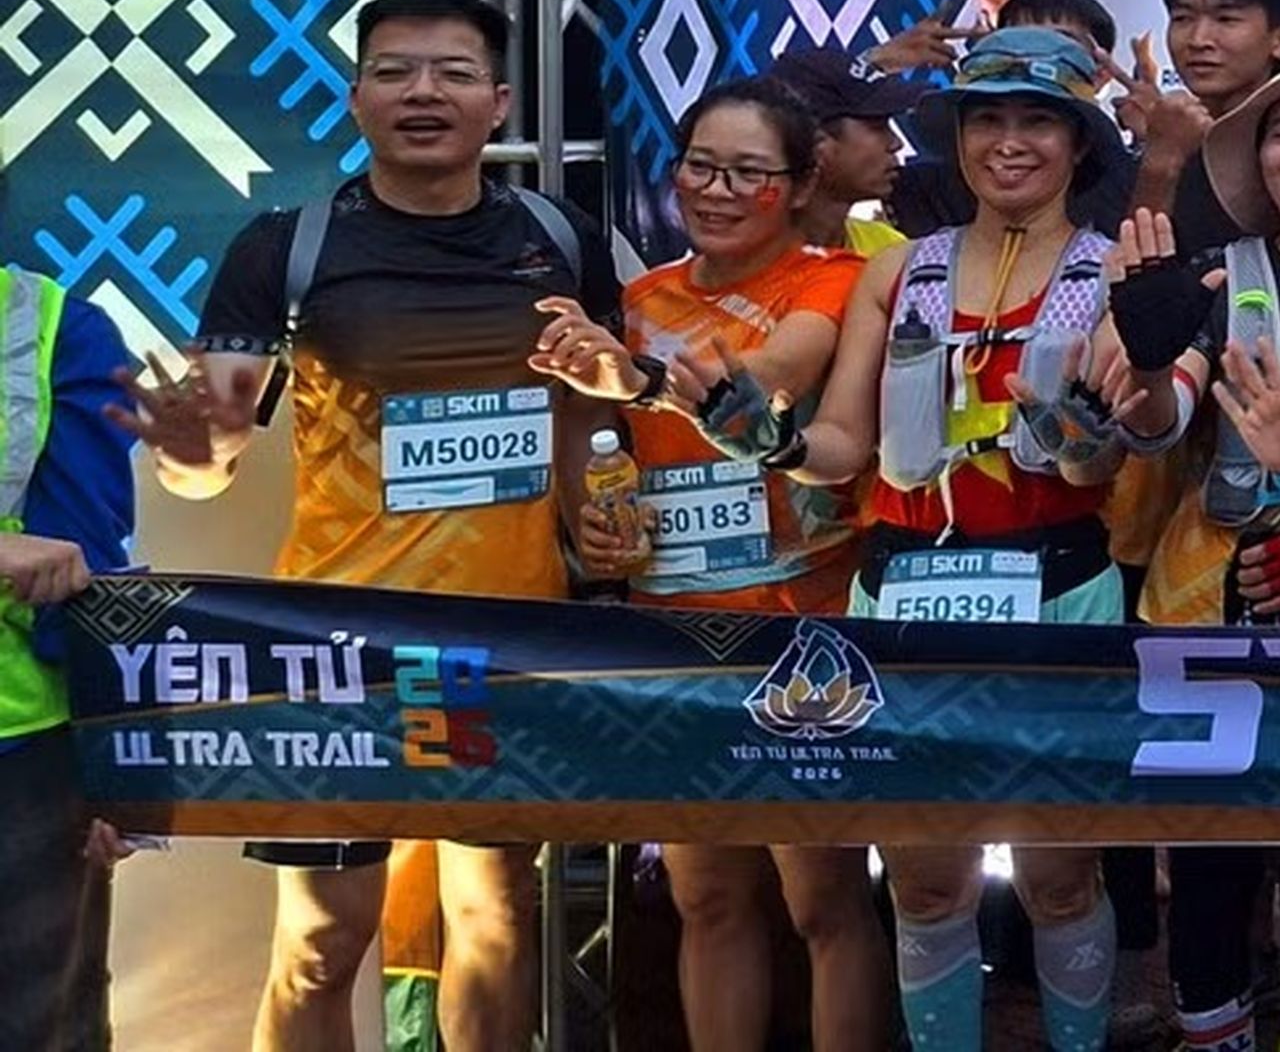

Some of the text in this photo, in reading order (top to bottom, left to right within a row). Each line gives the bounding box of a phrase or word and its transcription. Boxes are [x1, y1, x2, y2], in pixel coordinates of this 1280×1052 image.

[401, 430, 538, 468] M50028
[654, 500, 751, 535] 50183
[896, 593, 1016, 620] F50394
[110, 625, 490, 704] YÊN TỬ 20
[114, 709, 498, 767] ULTRA TRAIL 26
[791, 746, 845, 760] ULTRA
[851, 746, 898, 761] TRAIL
[791, 766, 843, 780] 2026
